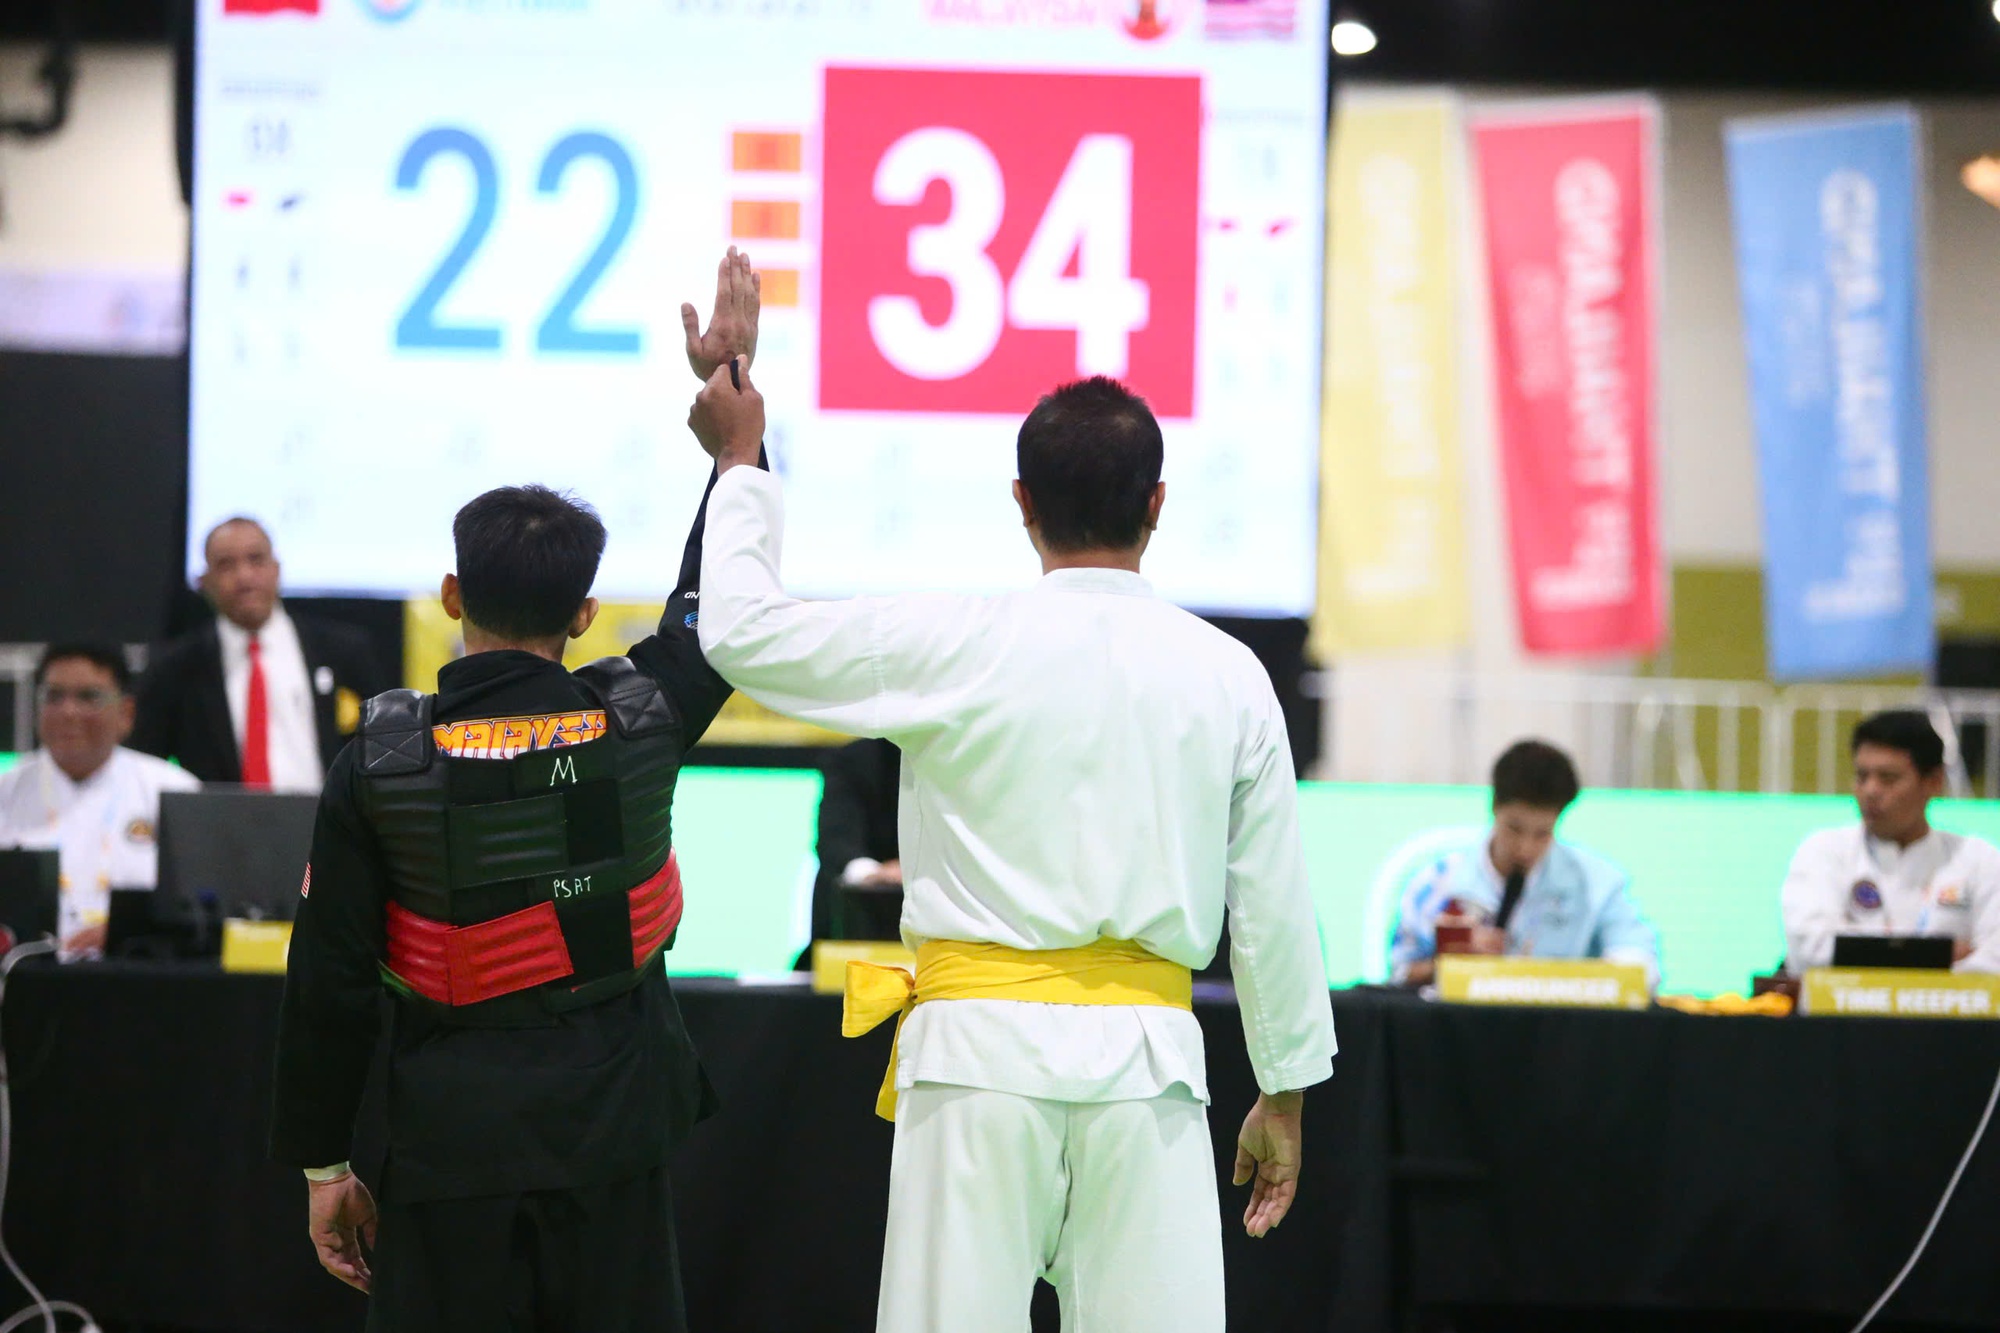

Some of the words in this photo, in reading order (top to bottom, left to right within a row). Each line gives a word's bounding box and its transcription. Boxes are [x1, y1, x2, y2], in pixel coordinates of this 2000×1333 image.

[394, 126, 642, 354] 22
[869, 127, 1149, 380] 34
[550, 756, 578, 786] M
[553, 876, 591, 898] PSAT
[1834, 988, 1891, 1012] TIME
[1896, 988, 1990, 1014] KEEPER
